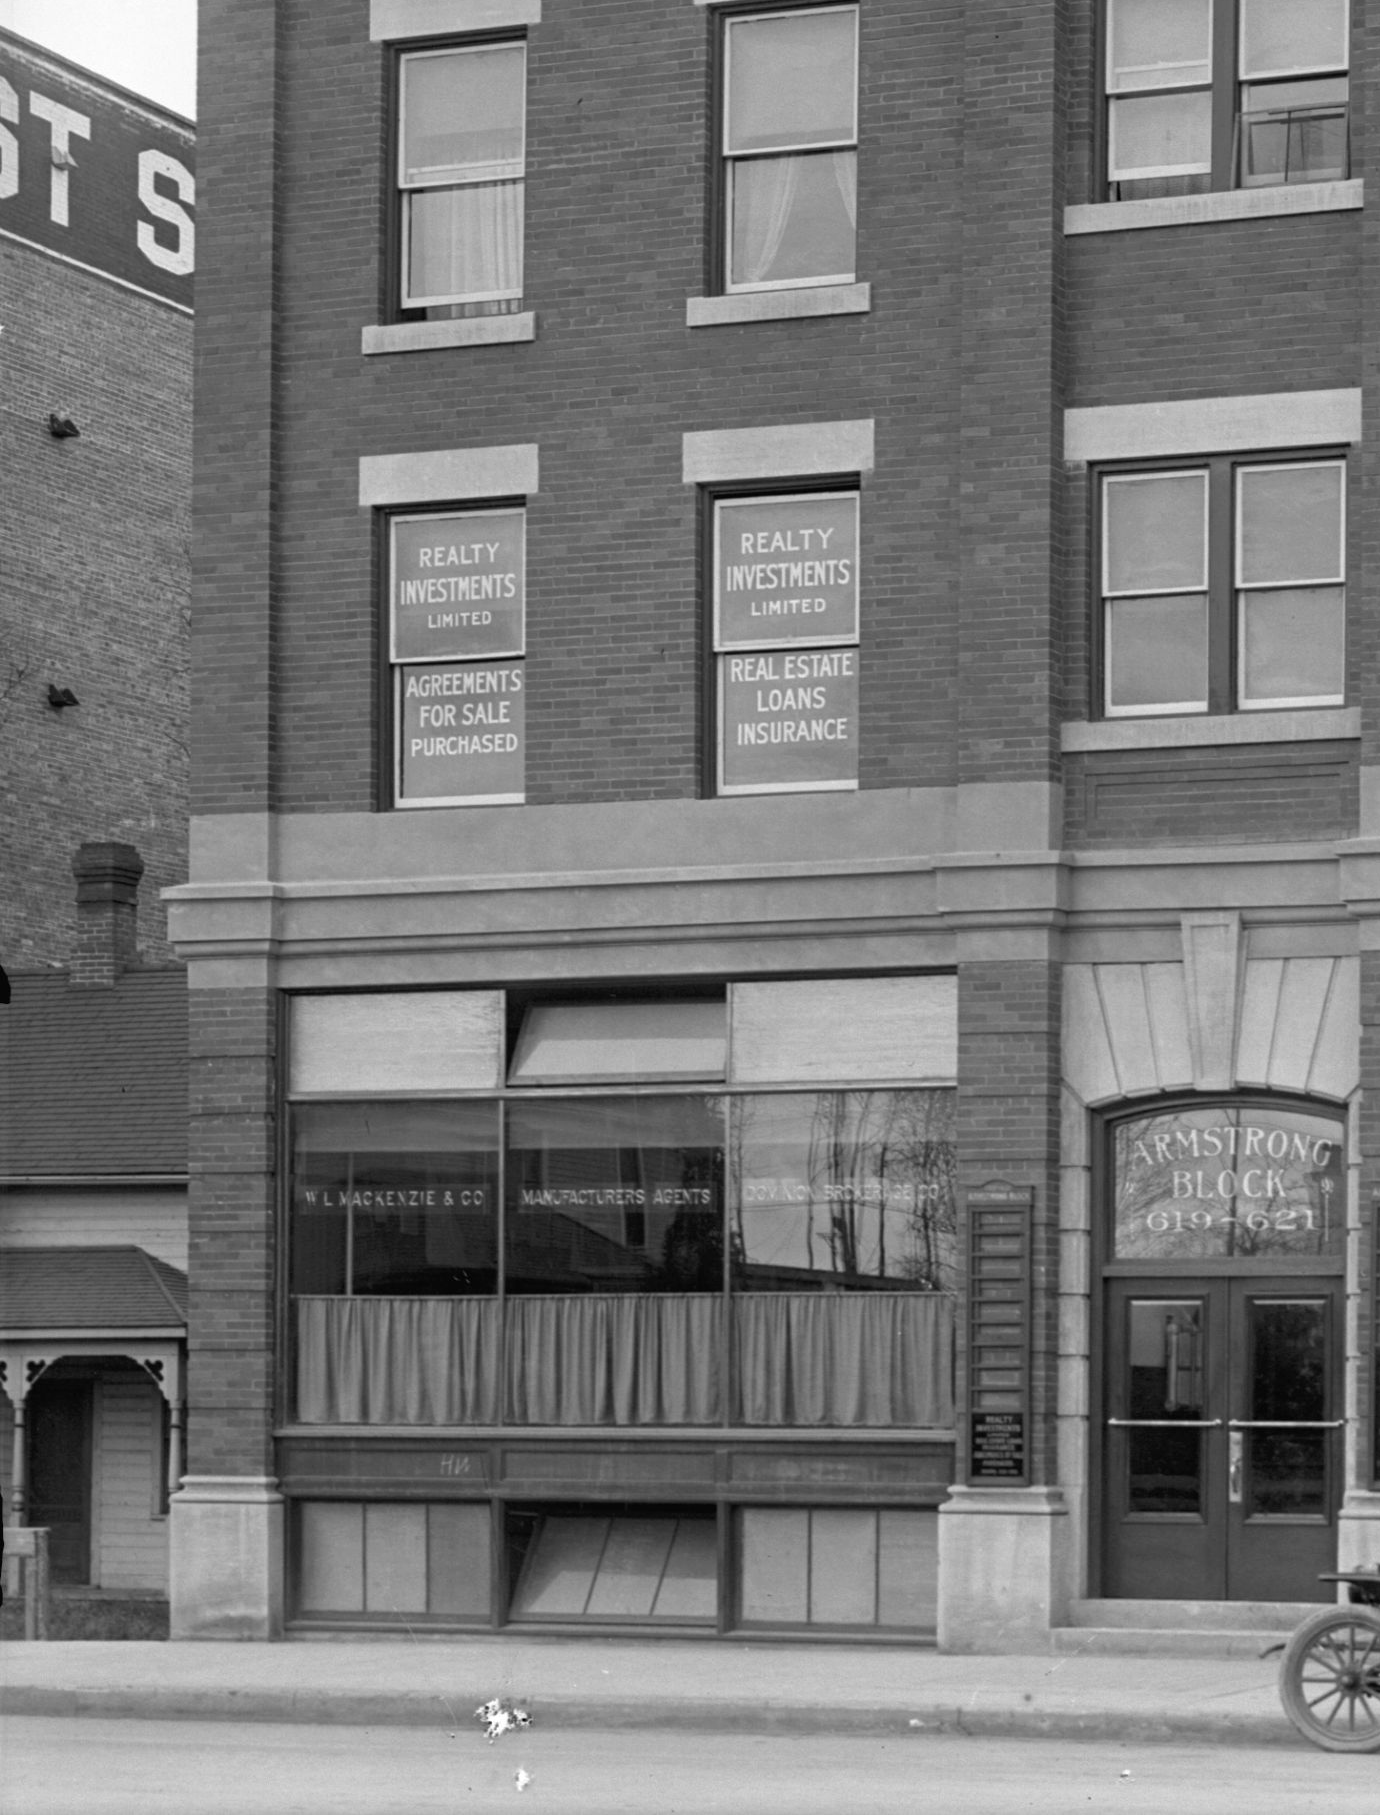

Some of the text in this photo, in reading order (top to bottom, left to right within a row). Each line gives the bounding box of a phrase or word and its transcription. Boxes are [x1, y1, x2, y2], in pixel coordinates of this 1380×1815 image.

[419, 542, 500, 568] REALTY
[741, 528, 835, 555] REALTY
[400, 573, 516, 605] INVESTMENTS
[727, 559, 851, 592] INVESTMENTS
[428, 611, 492, 629] LIMITED
[751, 598, 827, 616] LIMITED
[731, 653, 854, 683] REAL ESTATE
[406, 669, 522, 698] AGREEMENTS
[757, 687, 827, 712] LOANS
[420, 701, 511, 728] FOR SALE
[411, 733, 519, 758] PURCHASED
[737, 718, 849, 746] INSURANCE
[1132, 1127, 1333, 1170] ARMSTRONG
[521, 1188, 711, 1205] MANUFACTURERS AGENTS
[1172, 1169, 1288, 1199] BLOCK
[324, 1191, 333, 1206] L
[339, 1190, 436, 1207] MACKENZIE
[443, 1190, 454, 1206] &
[461, 1190, 484, 1205] CO
[1146, 1209, 1322, 1232] 619-621
